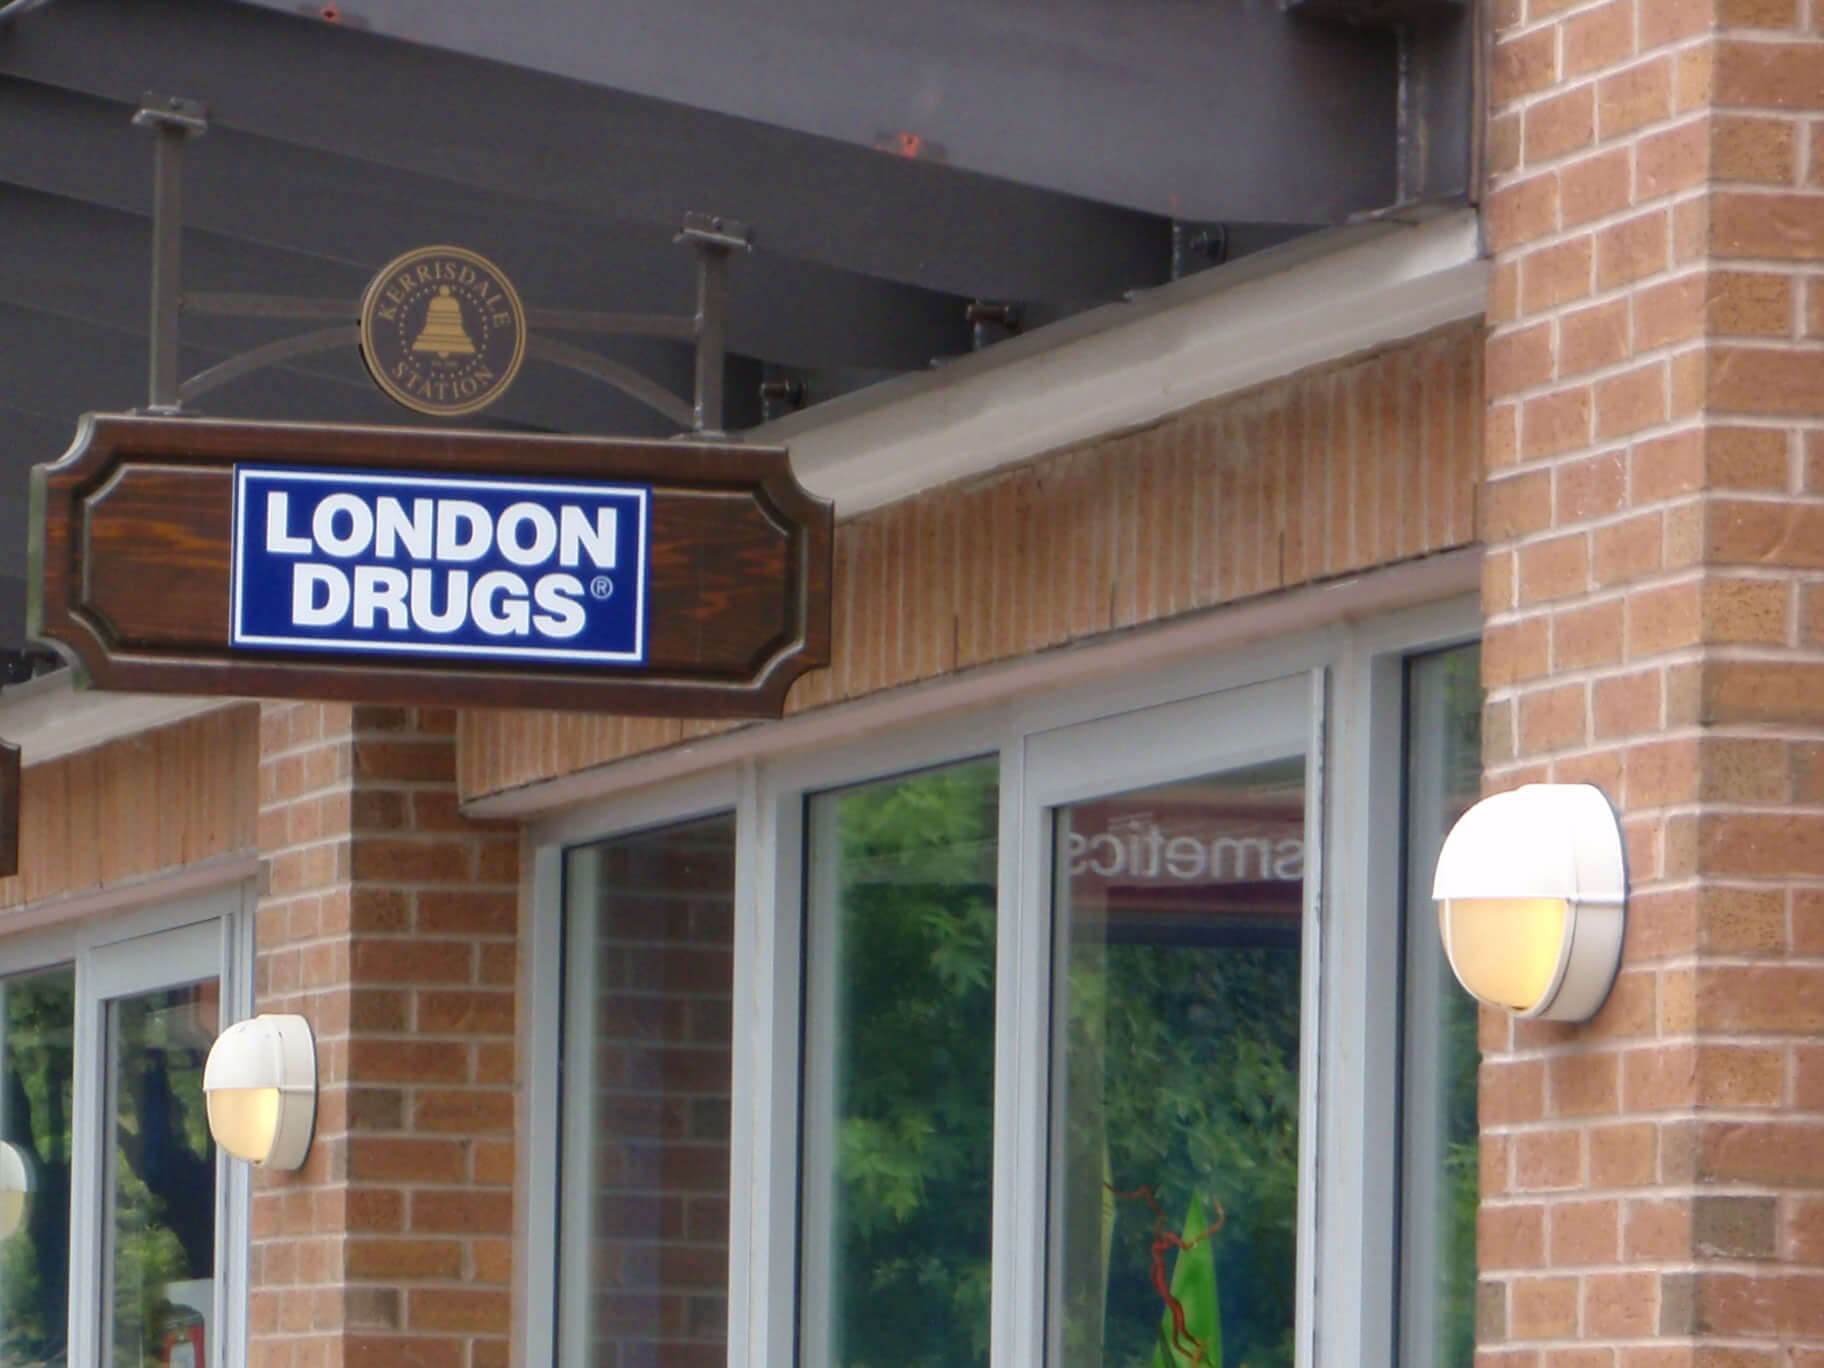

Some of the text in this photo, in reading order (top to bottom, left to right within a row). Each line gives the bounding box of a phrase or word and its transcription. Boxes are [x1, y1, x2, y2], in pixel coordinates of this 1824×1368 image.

[378, 260, 512, 329] KERRISDALE
[392, 360, 495, 400] STATION
[266, 491, 617, 568] LONDON
